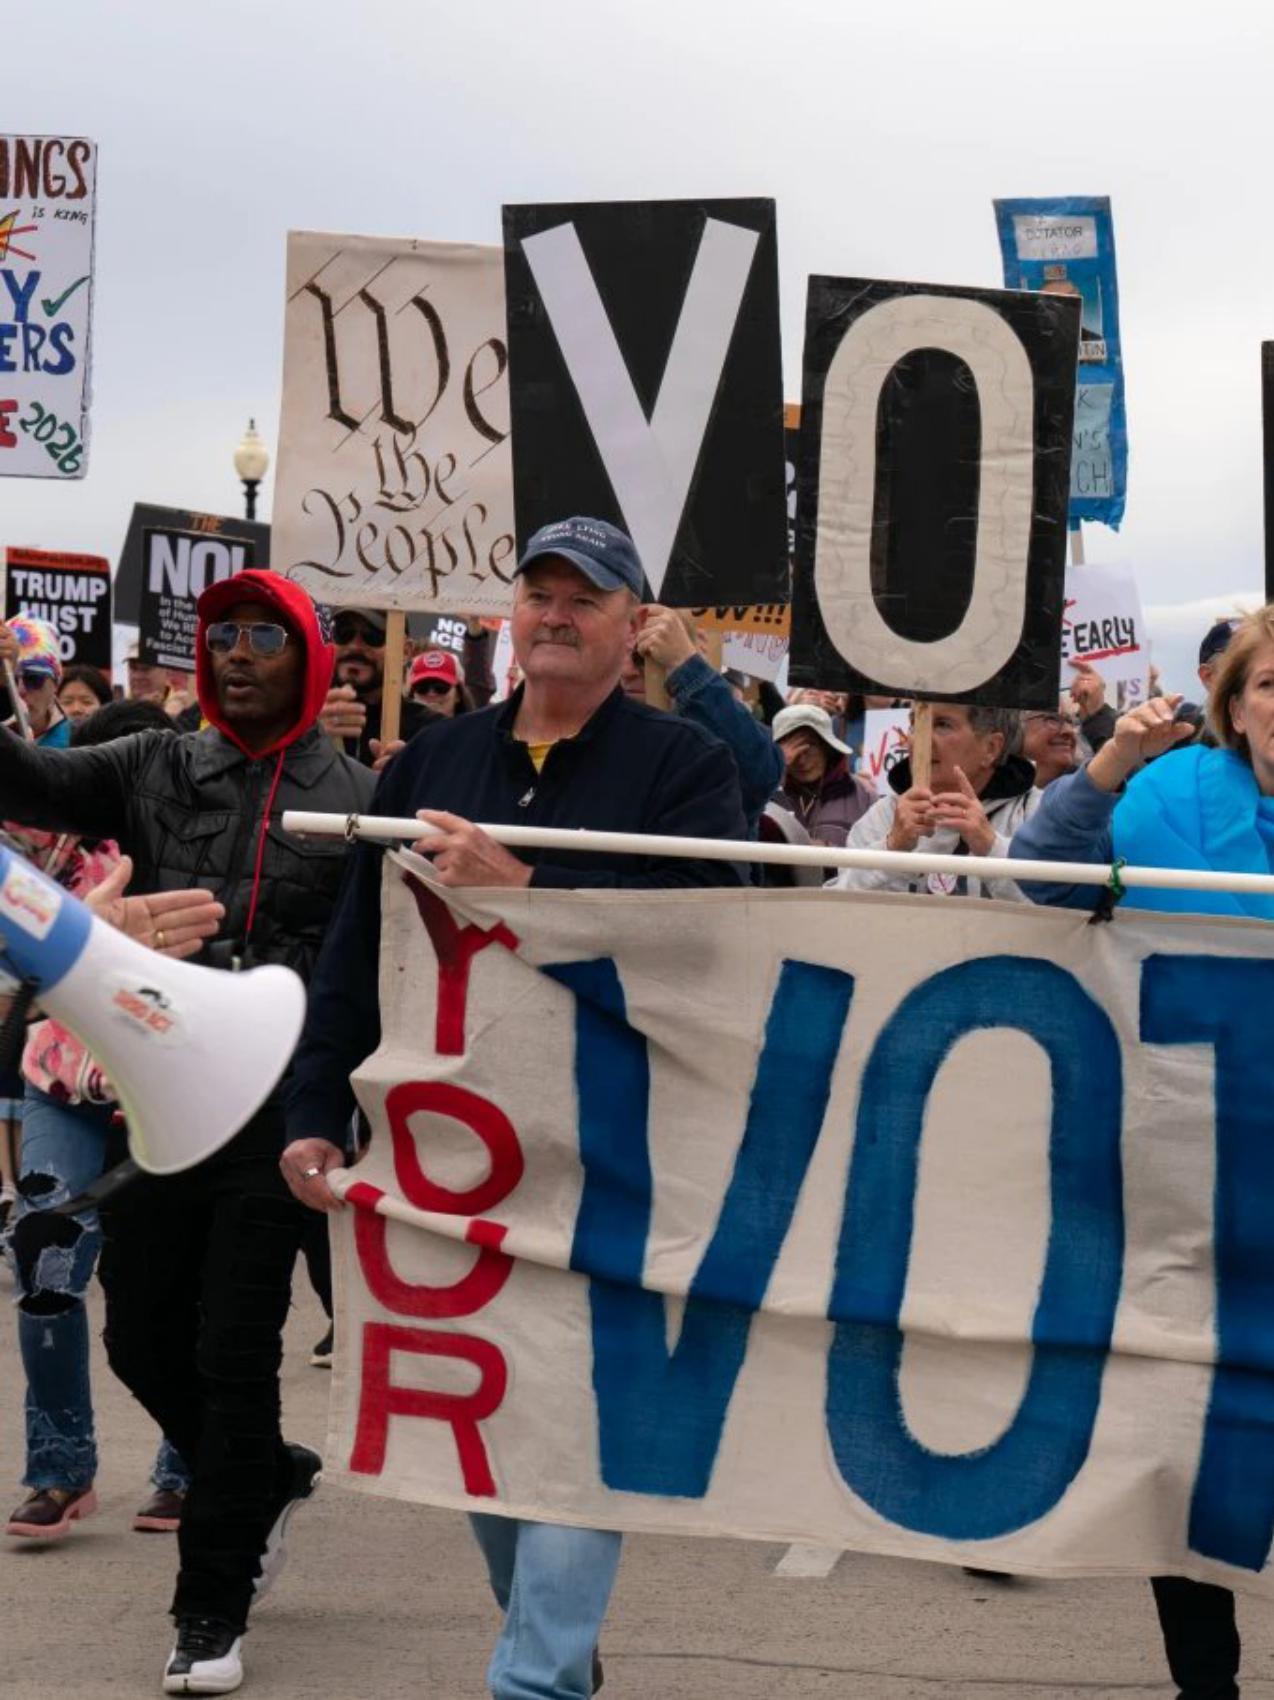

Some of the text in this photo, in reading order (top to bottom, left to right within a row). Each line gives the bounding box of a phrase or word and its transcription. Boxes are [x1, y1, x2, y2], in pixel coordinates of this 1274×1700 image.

[0, 138, 91, 200] INGS
[287, 252, 510, 467] We
[19, 401, 84, 474] 2026
[373, 431, 468, 512] the
[287, 488, 514, 598] People
[11, 569, 107, 602] TRUMP
[59, 634, 76, 661] O
[430, 629, 465, 652] ICE
[437, 617, 467, 638] NO
[1074, 616, 1136, 652] EARLY
[869, 731, 909, 777] VOT
[346, 872, 526, 1498] YOUR
